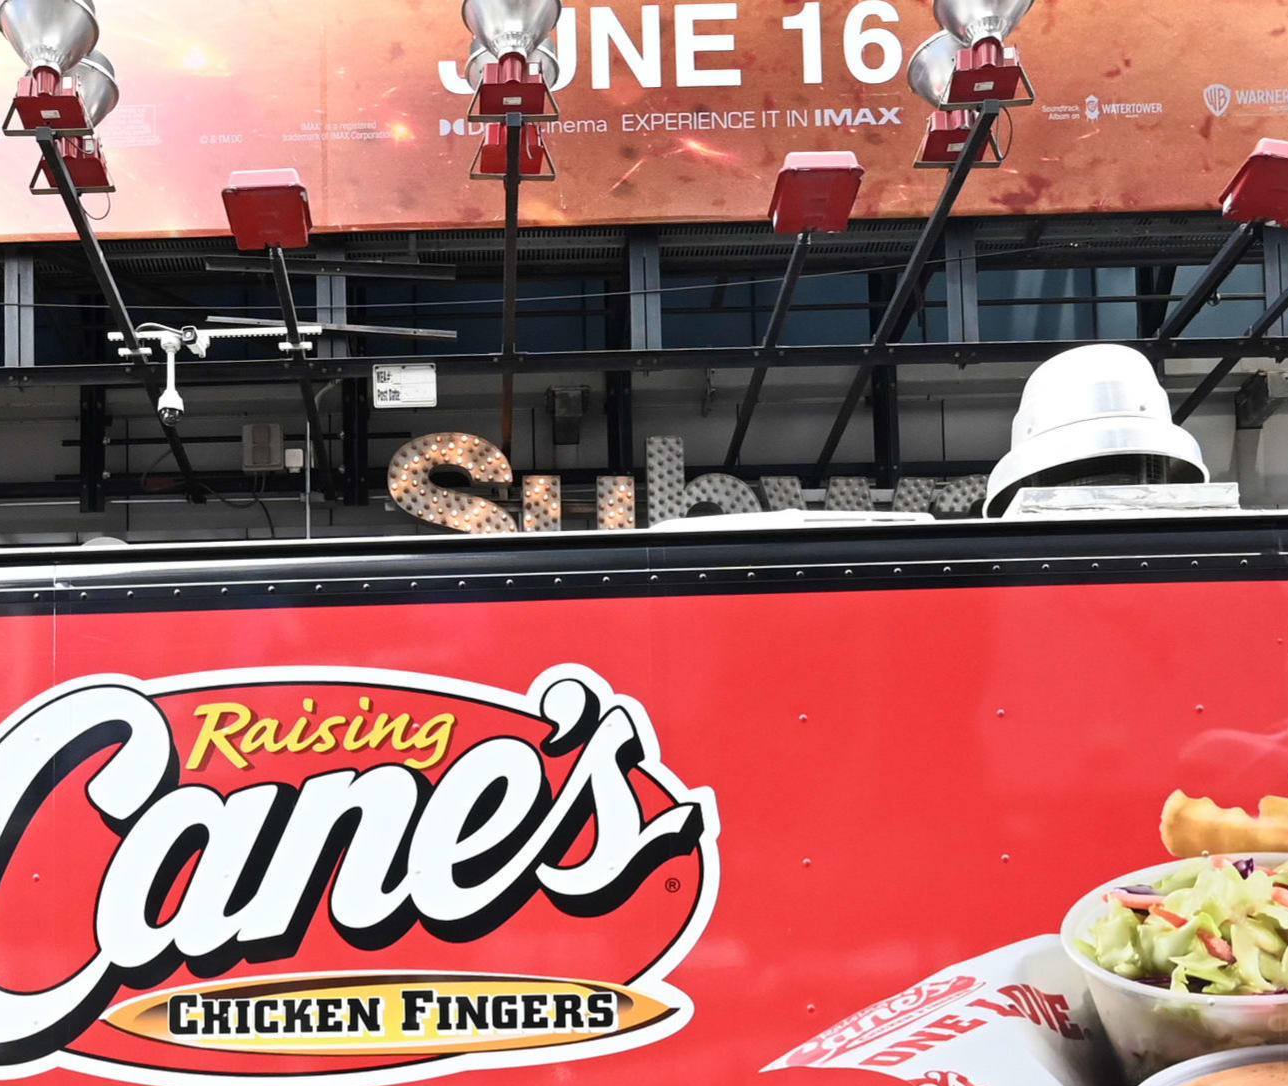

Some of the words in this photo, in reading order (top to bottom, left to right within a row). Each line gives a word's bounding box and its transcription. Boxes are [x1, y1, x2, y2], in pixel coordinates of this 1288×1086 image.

[783, 0, 903, 84] 16
[622, 110, 756, 132] EXPERIENCE
[761, 109, 782, 129] IT
[787, 108, 808, 128] IN
[815, 106, 902, 126] IMAX
[1042, 104, 1080, 113] Soundtrack
[1102, 103, 1163, 114] WATERTOWER
[185, 697, 455, 771] Raising
[167, 992, 382, 1037] CHICKEN
[401, 989, 616, 1033] FINGERS
[858, 1014, 988, 1066] ONE
